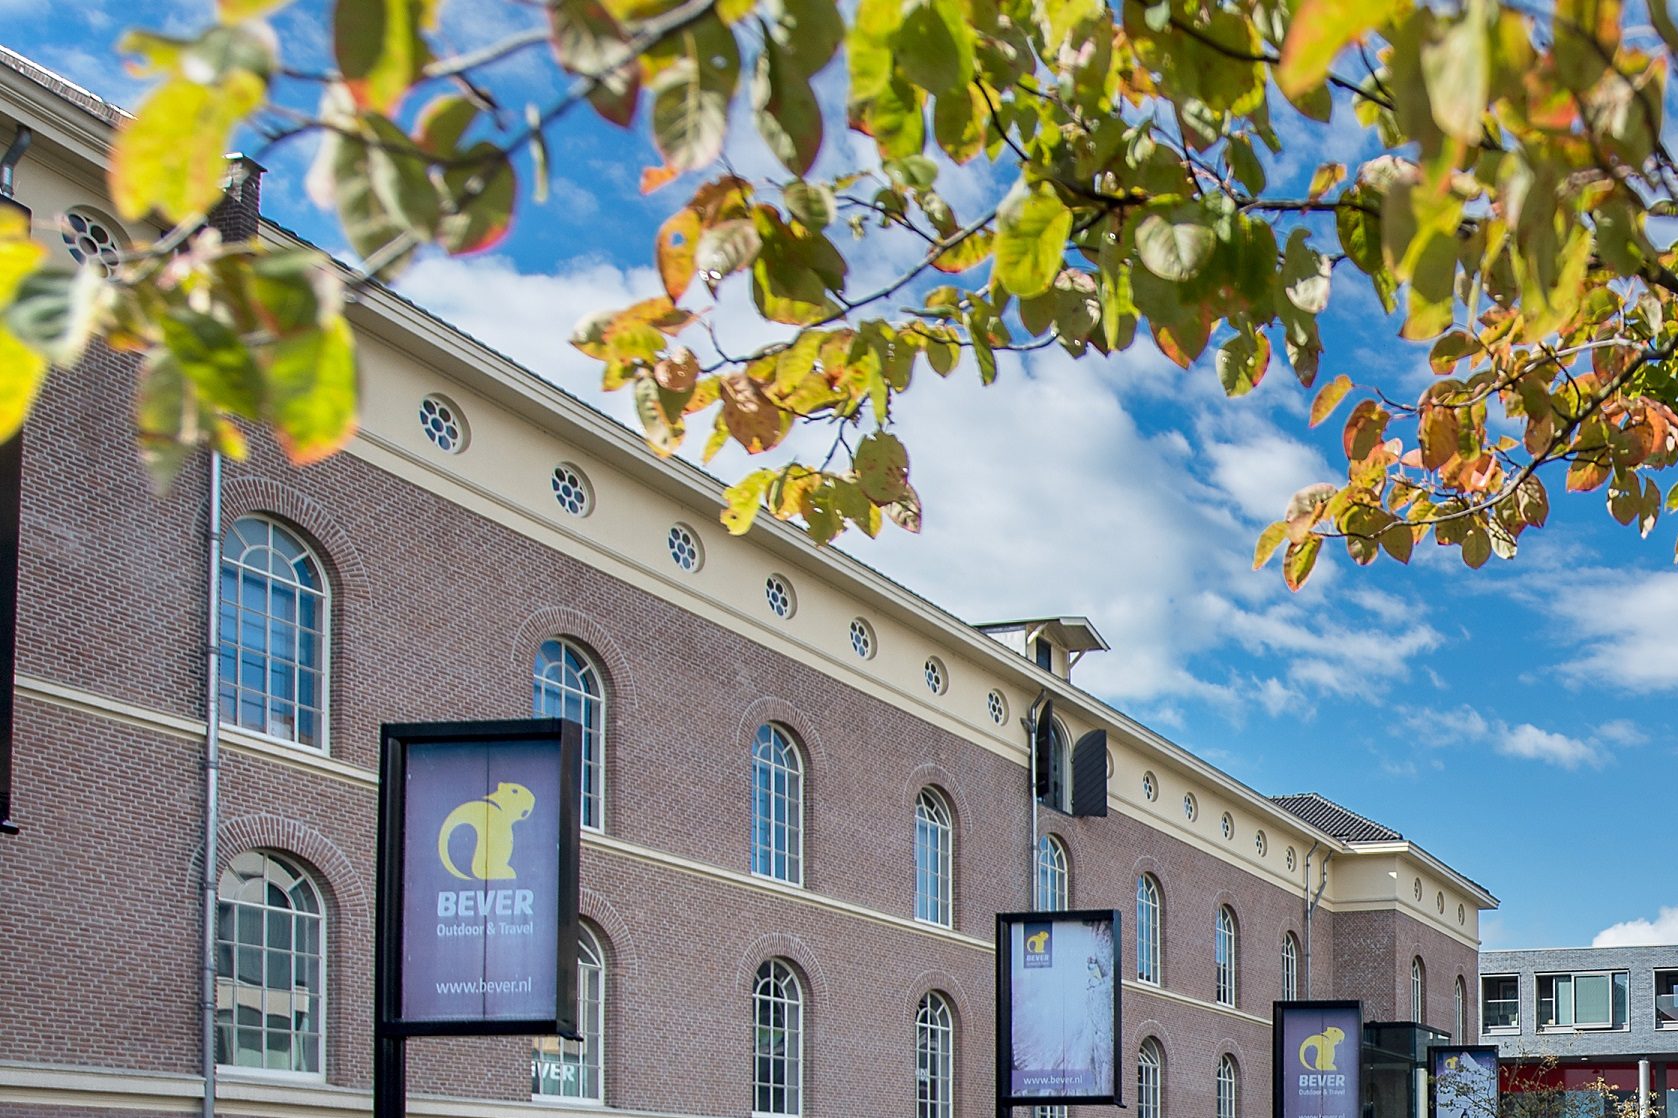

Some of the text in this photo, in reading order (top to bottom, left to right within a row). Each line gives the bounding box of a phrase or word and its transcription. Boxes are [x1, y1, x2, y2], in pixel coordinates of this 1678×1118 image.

[437, 889, 534, 917] BEVER
[437, 921, 534, 937] Outdoor & Travel
[436, 976, 532, 994] www.bever.nl
[1023, 1074, 1083, 1087] www.bever.nl
[1298, 1074, 1346, 1087] BEVER
